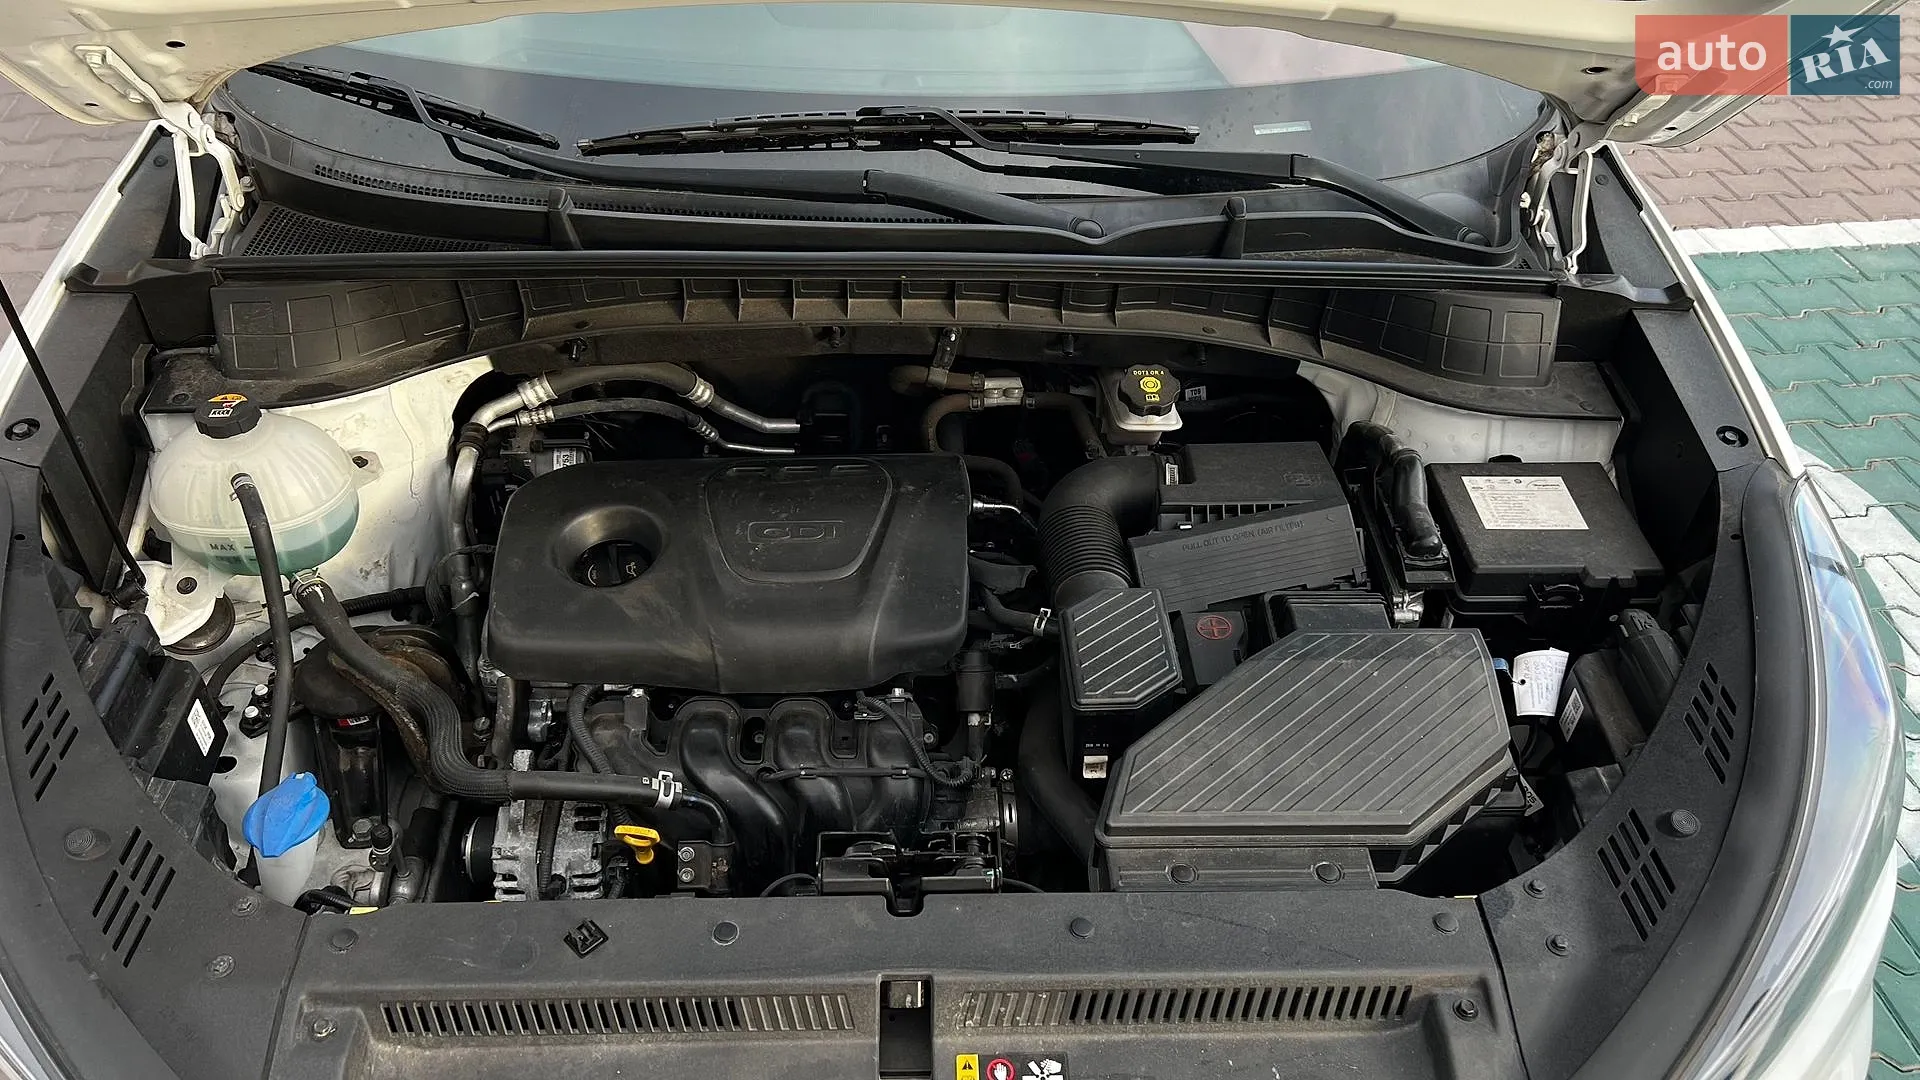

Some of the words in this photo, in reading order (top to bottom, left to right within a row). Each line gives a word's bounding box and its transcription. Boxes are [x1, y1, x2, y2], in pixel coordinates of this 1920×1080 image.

[763, 526, 837, 540] GDI
[209, 543, 236, 552] MAX
[1182, 541, 1202, 552] PULL
[1203, 537, 1219, 547] OUT
[300, 583, 324, 598] TANK
